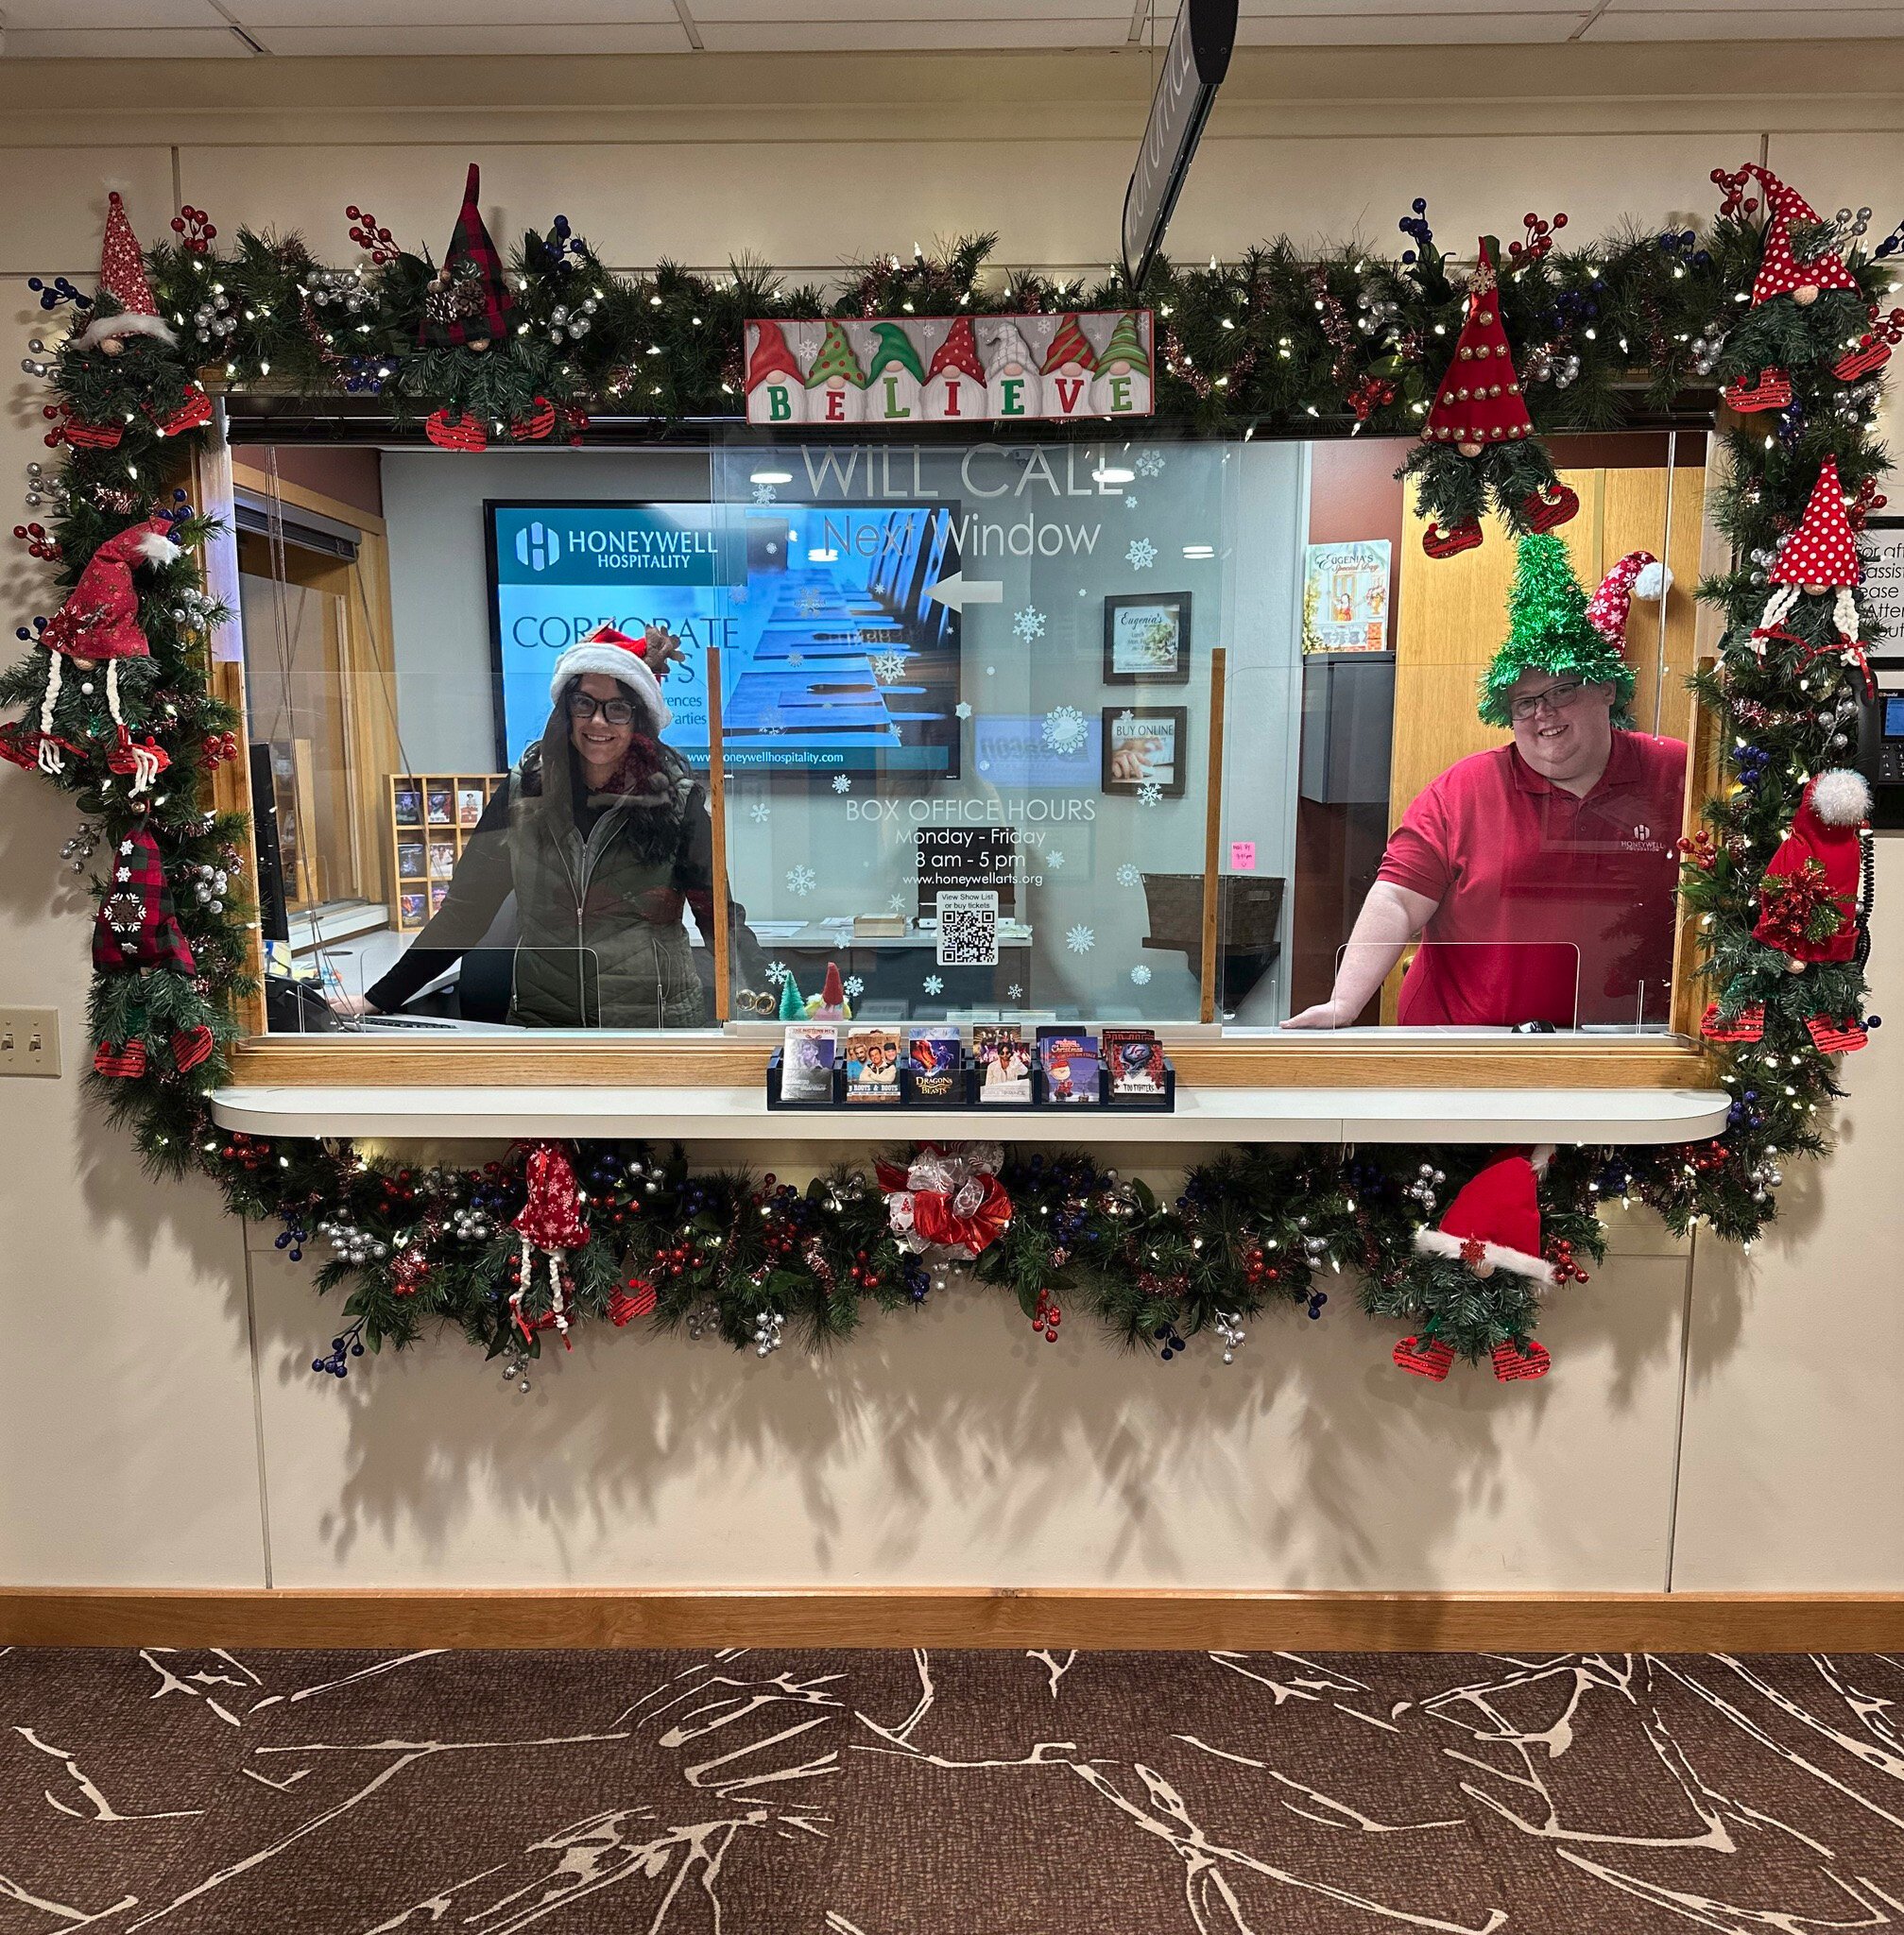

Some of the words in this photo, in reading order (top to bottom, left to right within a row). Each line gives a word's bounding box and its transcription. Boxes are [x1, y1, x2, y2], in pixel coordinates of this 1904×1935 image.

[767, 377, 1132, 420] BELIEVE
[800, 444, 938, 497] WILL
[961, 442, 1123, 497] CALL
[569, 531, 718, 554] HONEYWELL
[825, 515, 917, 557] Next
[931, 513, 1102, 557] Window
[598, 555, 690, 569] HOSPITALITY
[1315, 554, 1373, 571] EUGENIA'S
[1866, 563, 1904, 578] assis
[1868, 603, 1904, 618] Atte
[1121, 612, 1162, 630] Eugenia's
[513, 616, 740, 648] COROATE
[1117, 726, 1136, 736] BUY
[1138, 725, 1174, 736] ONLINE
[846, 799, 899, 821] BOX
[908, 799, 1001, 821] OFFICE
[1008, 799, 1096, 821] HOURS
[896, 829, 973, 848] Monday
[991, 829, 1046, 848] Friday
[1621, 841, 1664, 849] HONEYWELL
[915, 852, 926, 867] 8
[931, 855, 962, 867] am
[979, 852, 989, 867] 5
[995, 855, 1026, 872] pm
[902, 872, 1043, 886] www.honeywellarts.org
